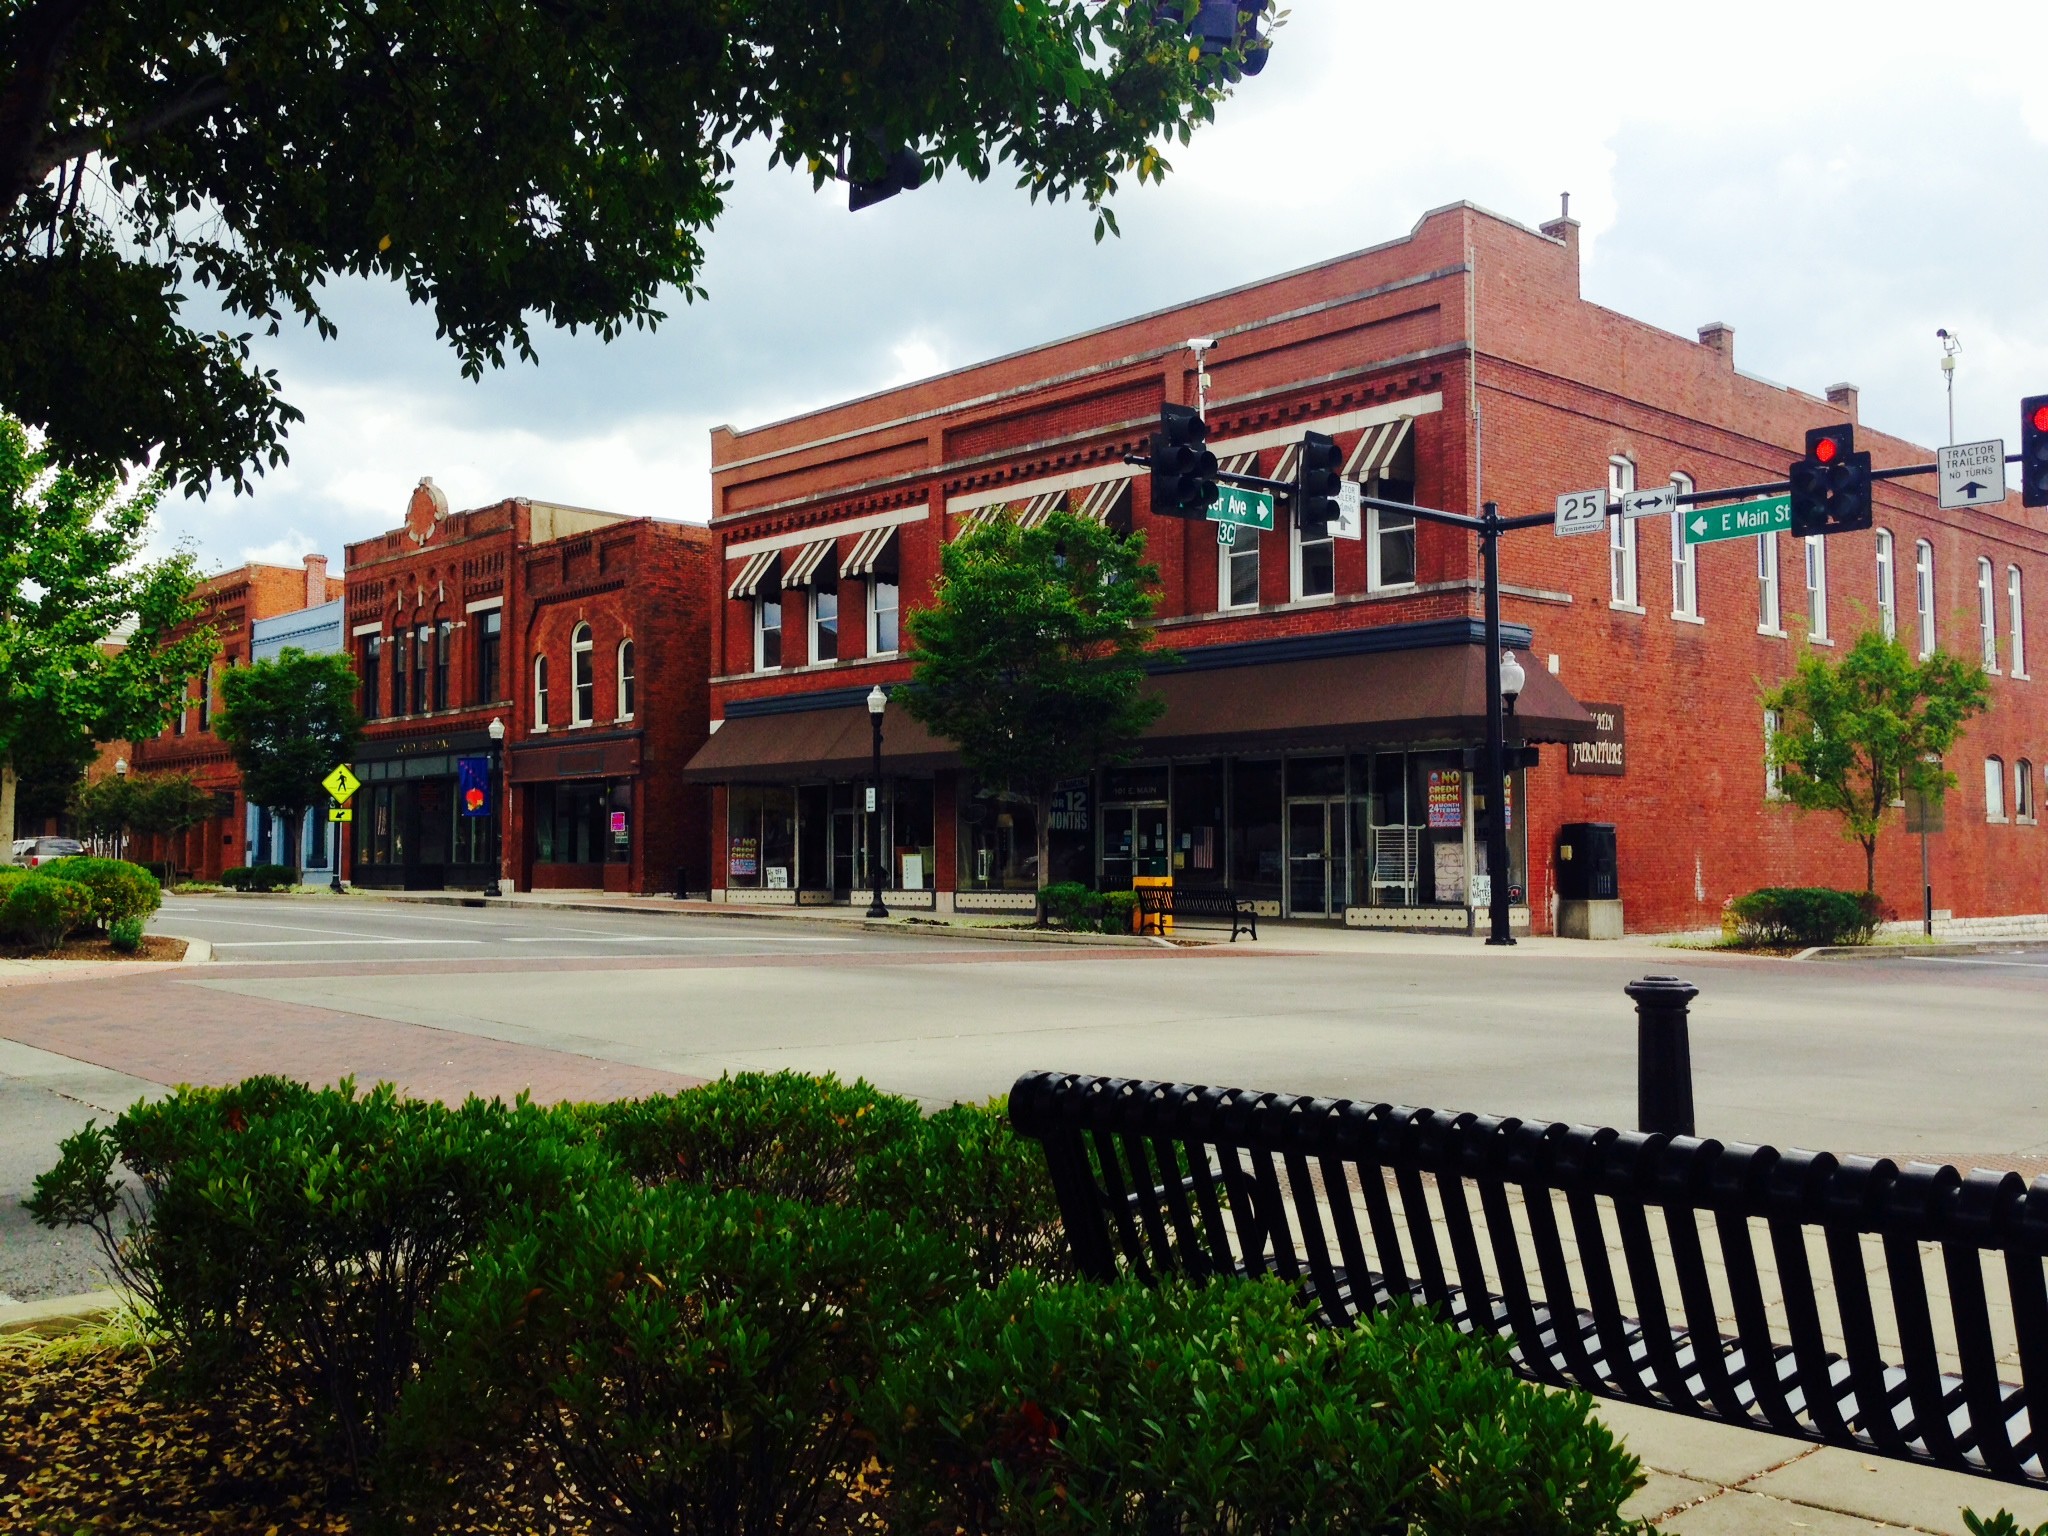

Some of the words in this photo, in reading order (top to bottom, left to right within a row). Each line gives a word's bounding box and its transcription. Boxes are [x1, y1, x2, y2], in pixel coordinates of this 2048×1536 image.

[1947, 445, 1994, 459] TRACTOR
[1946, 454, 1996, 469] TRAILERS
[1949, 471, 1961, 480] NO
[1965, 467, 1993, 477] TURNS
[1228, 494, 1247, 516] Ave
[1564, 495, 1598, 521] 25
[1625, 502, 1632, 512] E
[1664, 493, 1674, 506] W
[1721, 513, 1732, 531] E
[1737, 510, 1769, 529] Main
[1774, 505, 1790, 523] St
[1219, 522, 1235, 543] 3C
[1560, 524, 1597, 533] Tennessee
[1572, 739, 1623, 767] FURNITURE
[1441, 770, 1460, 784] NO
[1136, 786, 1157, 795] MAIN
[1428, 785, 1460, 794] CREDIT
[1065, 791, 1087, 812] 12
[1428, 793, 1459, 803] CHECK
[1428, 804, 1439, 813] 24
[1048, 811, 1088, 830] MONTHS
[742, 838, 757, 847] NO
